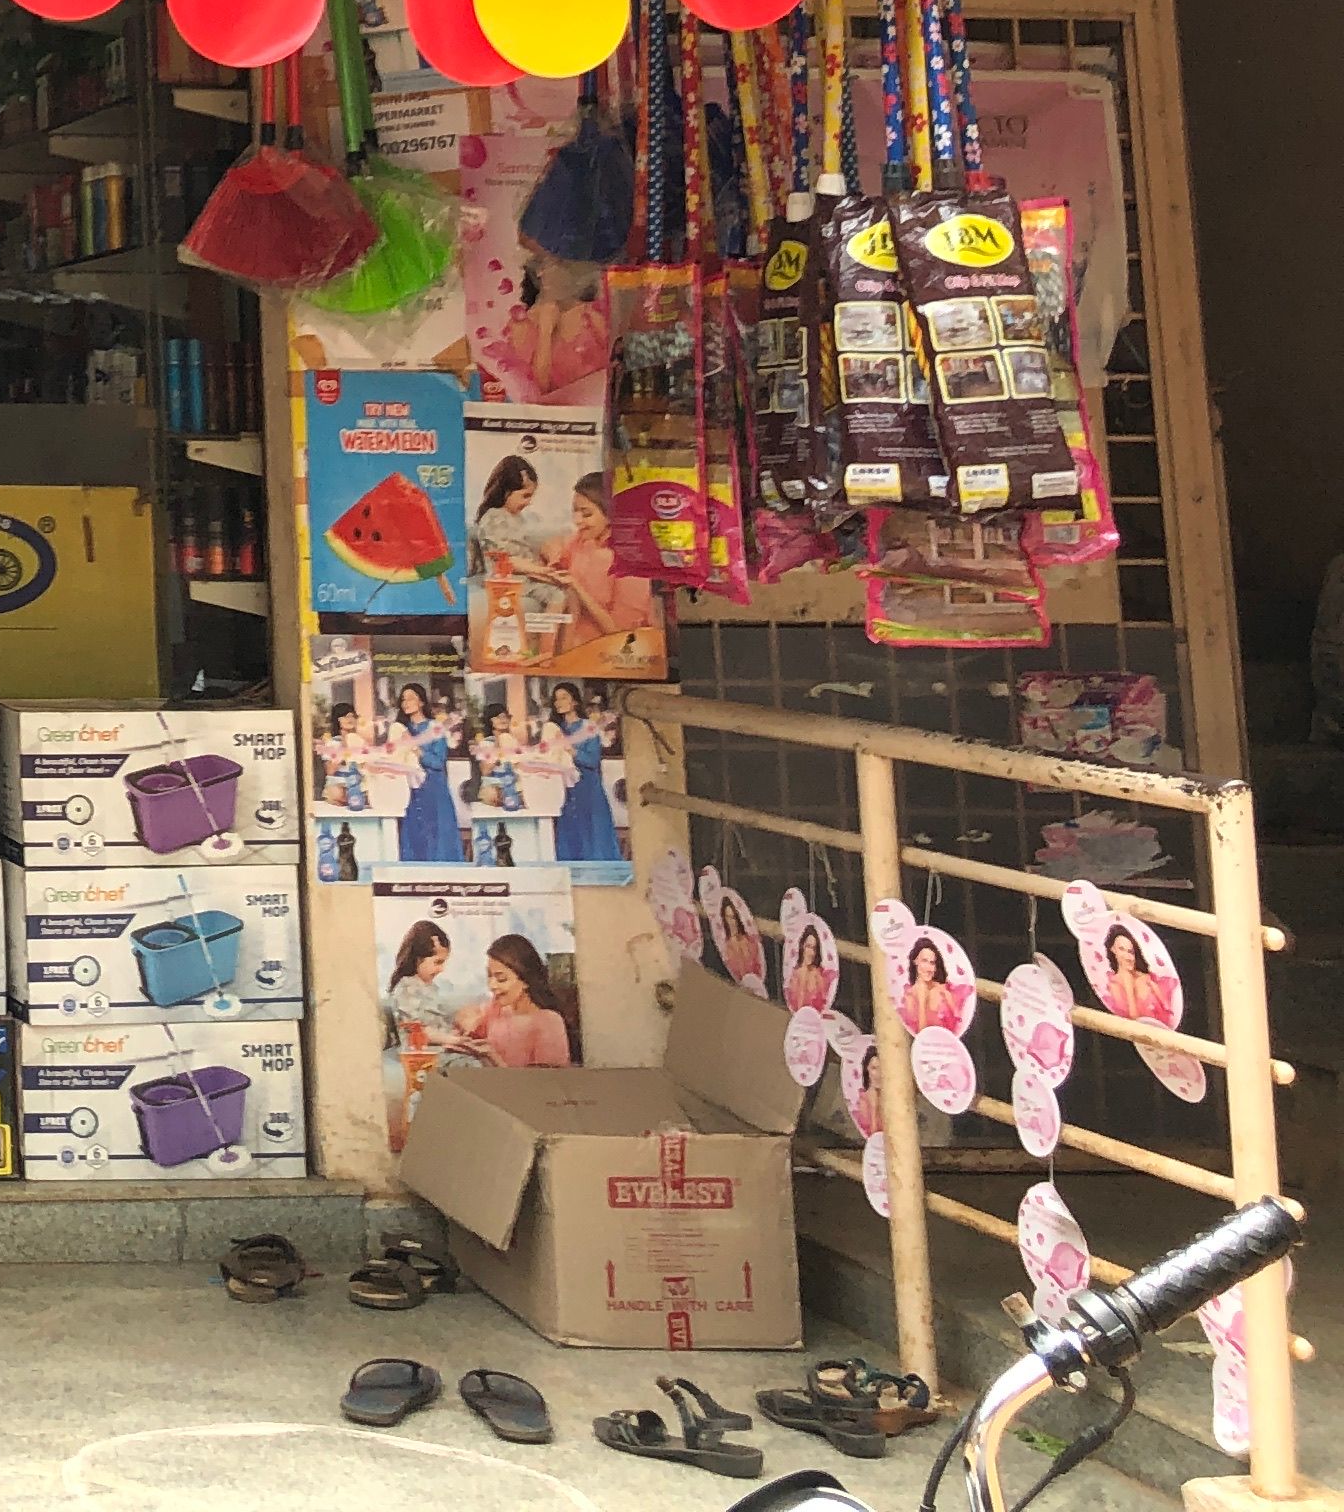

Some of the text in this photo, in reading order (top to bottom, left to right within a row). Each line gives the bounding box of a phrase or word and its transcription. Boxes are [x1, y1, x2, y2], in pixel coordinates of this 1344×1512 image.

[341, 430, 436, 452] WATERMELON
[37, 722, 120, 743] Greenchef
[232, 733, 286, 747] SMART
[43, 883, 124, 904] Greenchef
[245, 893, 289, 906] SMART
[41, 1034, 124, 1054] Greenchef
[241, 1043, 294, 1058] SMART
[261, 1058, 294, 1071] MOP
[614, 1181, 726, 1204] EVEREST
[606, 1299, 755, 1312] HANDLE WITH CARE
